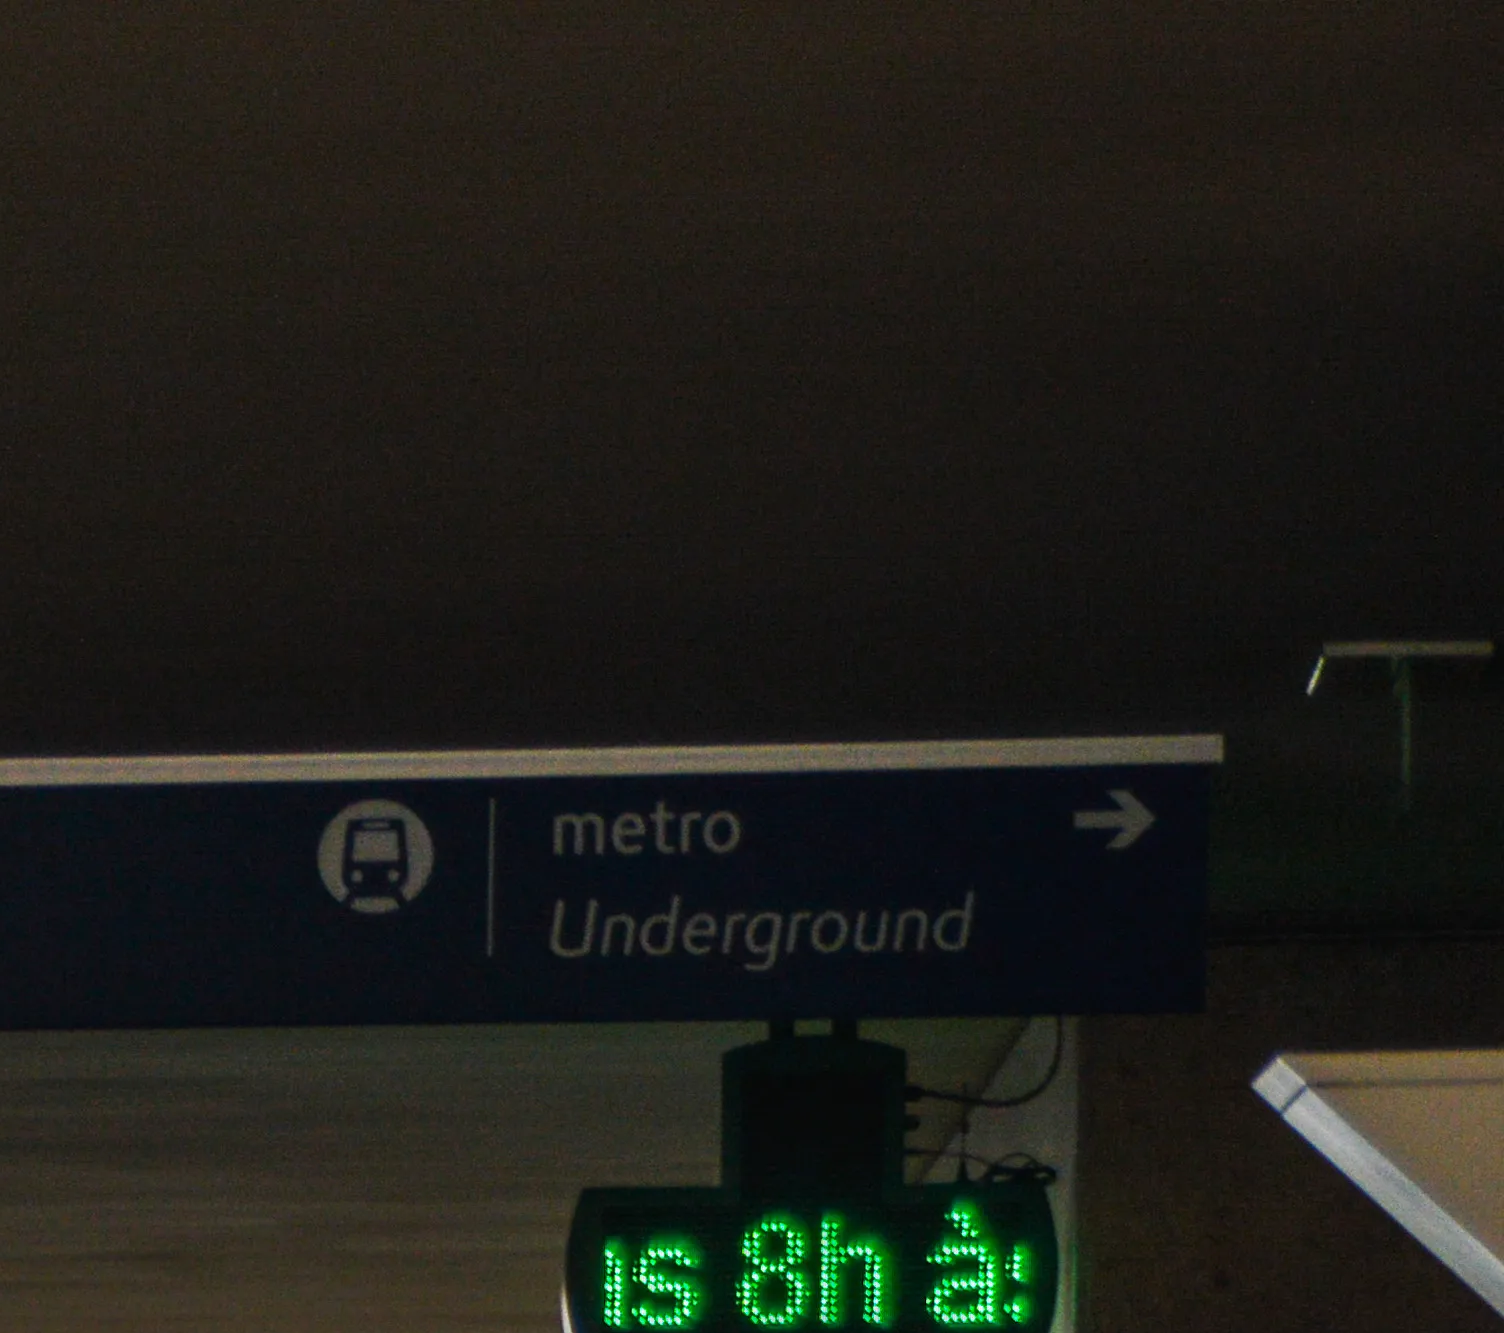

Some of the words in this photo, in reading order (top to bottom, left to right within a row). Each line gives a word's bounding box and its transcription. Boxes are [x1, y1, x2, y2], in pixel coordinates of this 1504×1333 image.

[553, 802, 743, 856] metro
[548, 892, 977, 973] Underground
[735, 1218, 890, 1327] 8h
